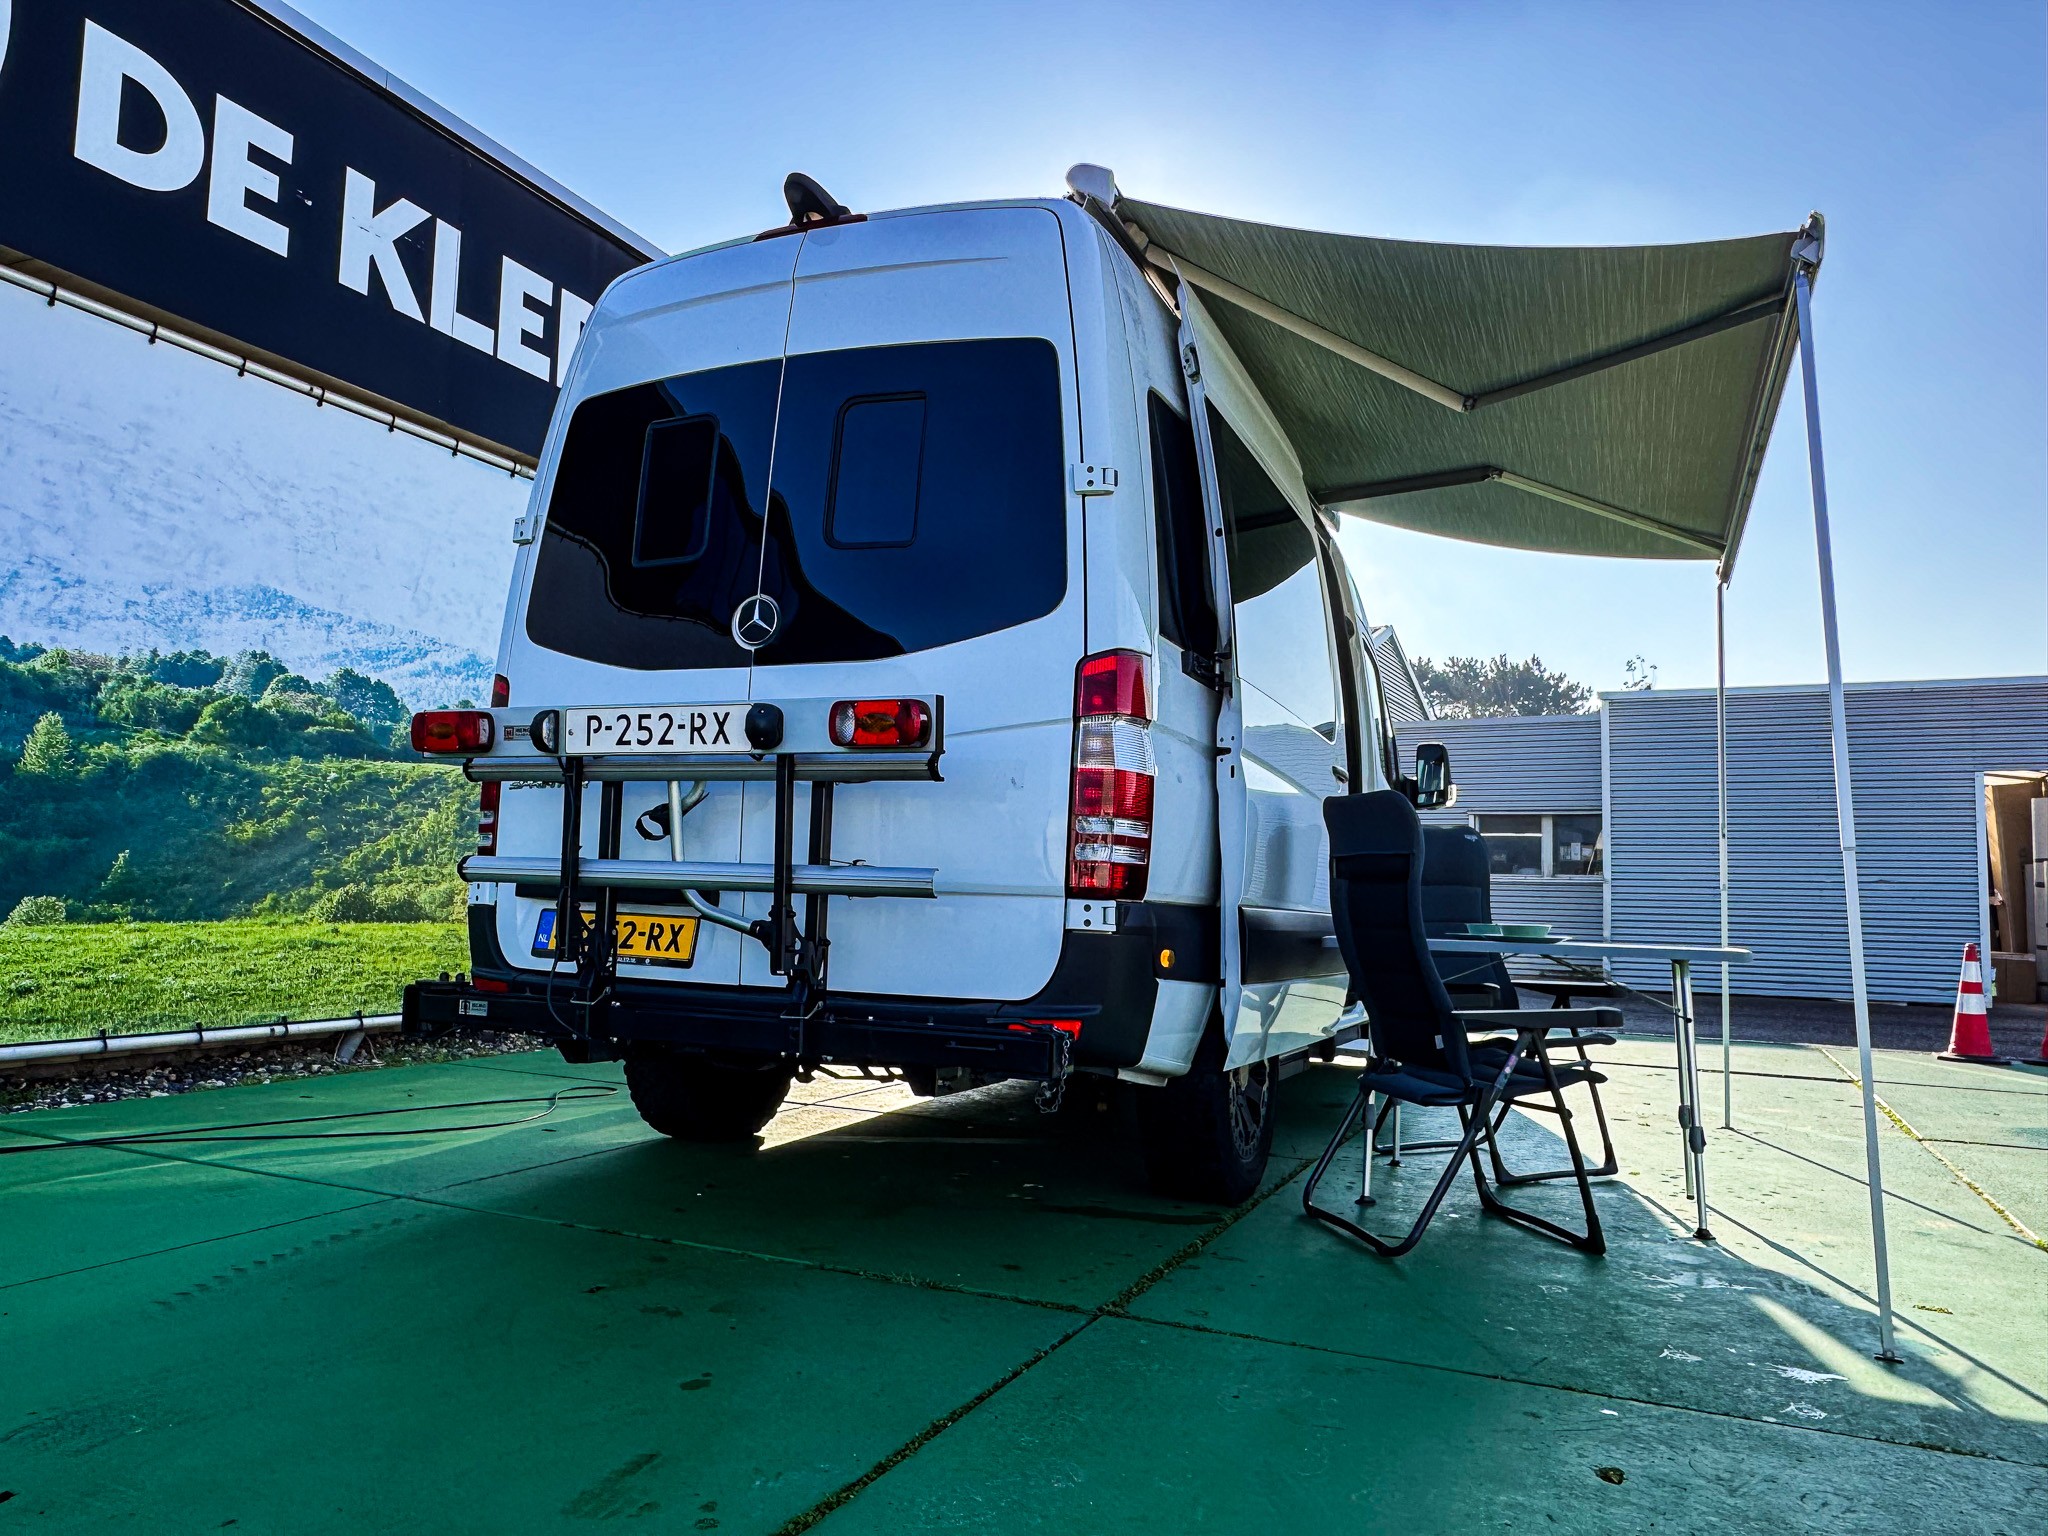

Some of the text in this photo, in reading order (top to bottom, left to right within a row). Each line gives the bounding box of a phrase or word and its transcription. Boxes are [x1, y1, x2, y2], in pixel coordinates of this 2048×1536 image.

[74, 18, 294, 258] DE
[586, 711, 731, 747] P-252-RX
[537, 932, 549, 943] NL
